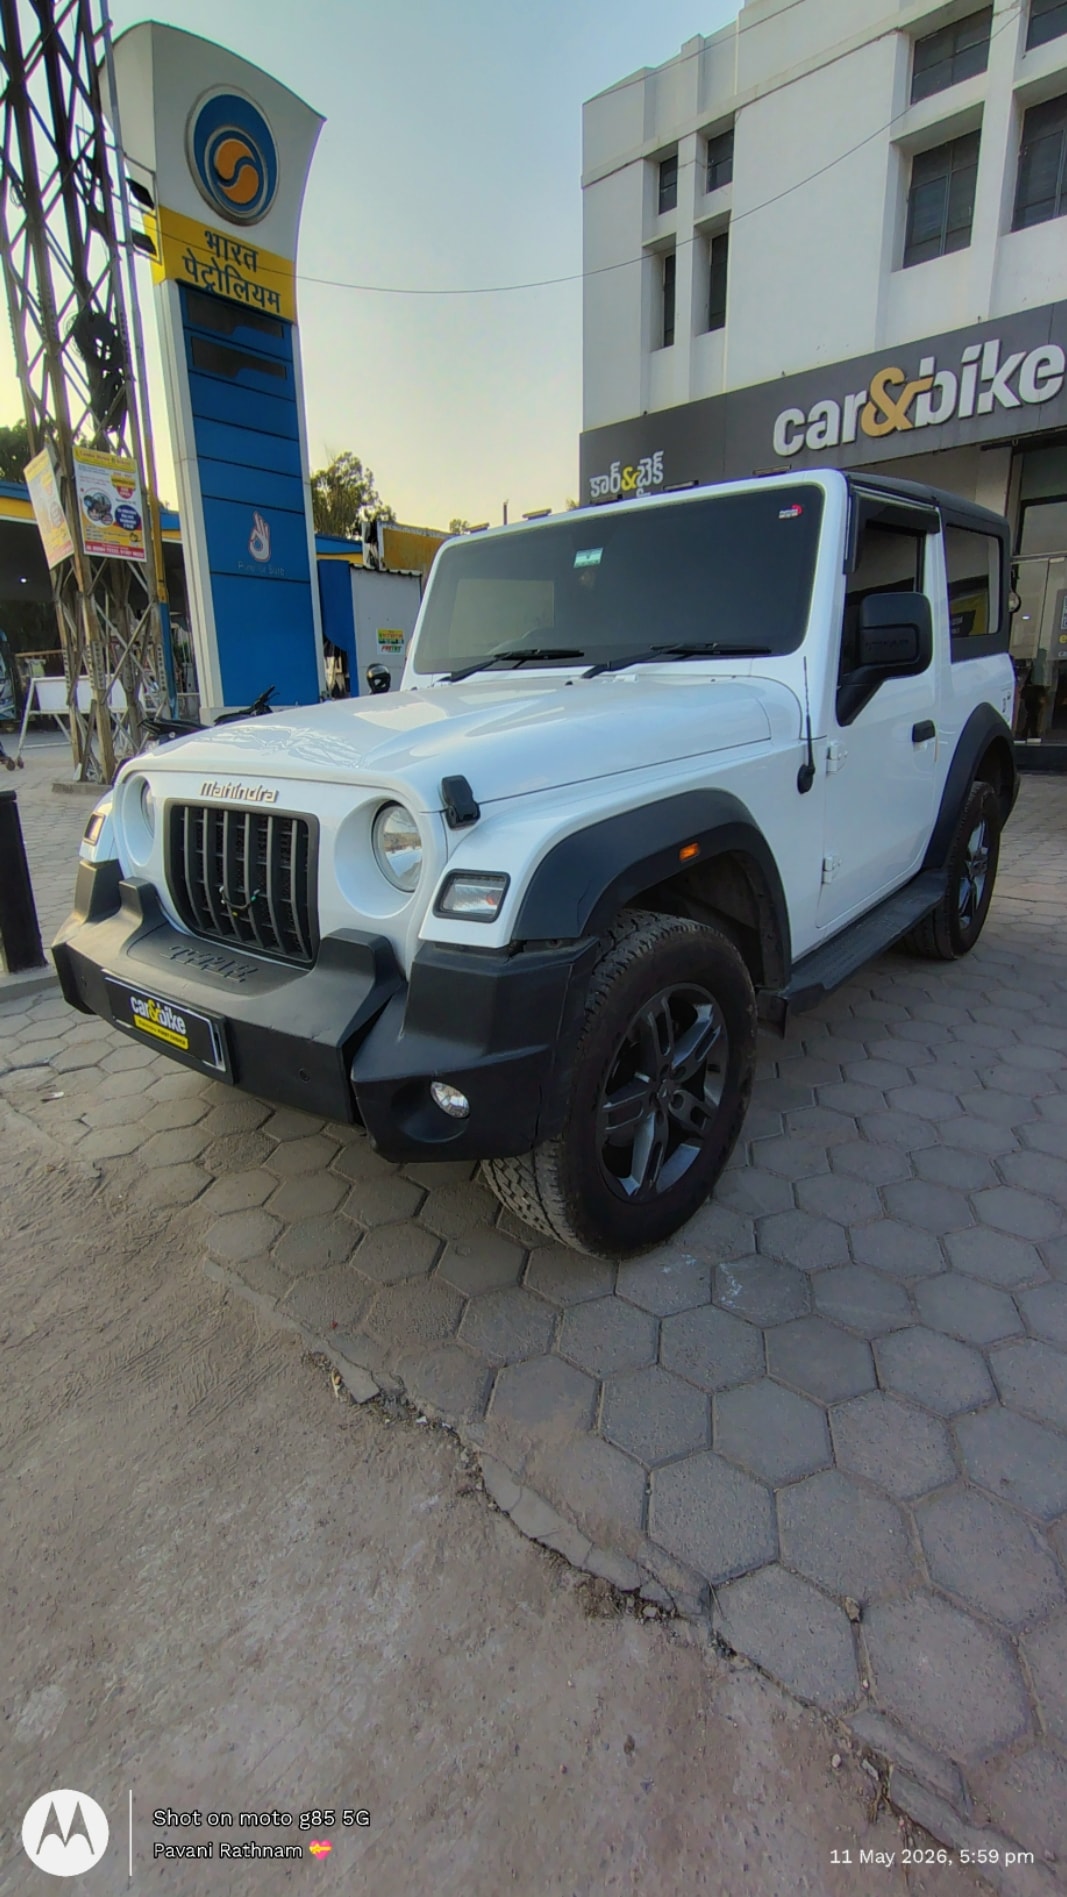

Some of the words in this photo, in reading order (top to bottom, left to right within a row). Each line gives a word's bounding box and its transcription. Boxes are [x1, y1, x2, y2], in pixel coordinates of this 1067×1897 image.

[205, 231, 258, 272] भारत
[182, 248, 281, 313] पेट्रोलियम
[773, 339, 1066, 457] car&bike
[130, 996, 187, 1035] car&bike
